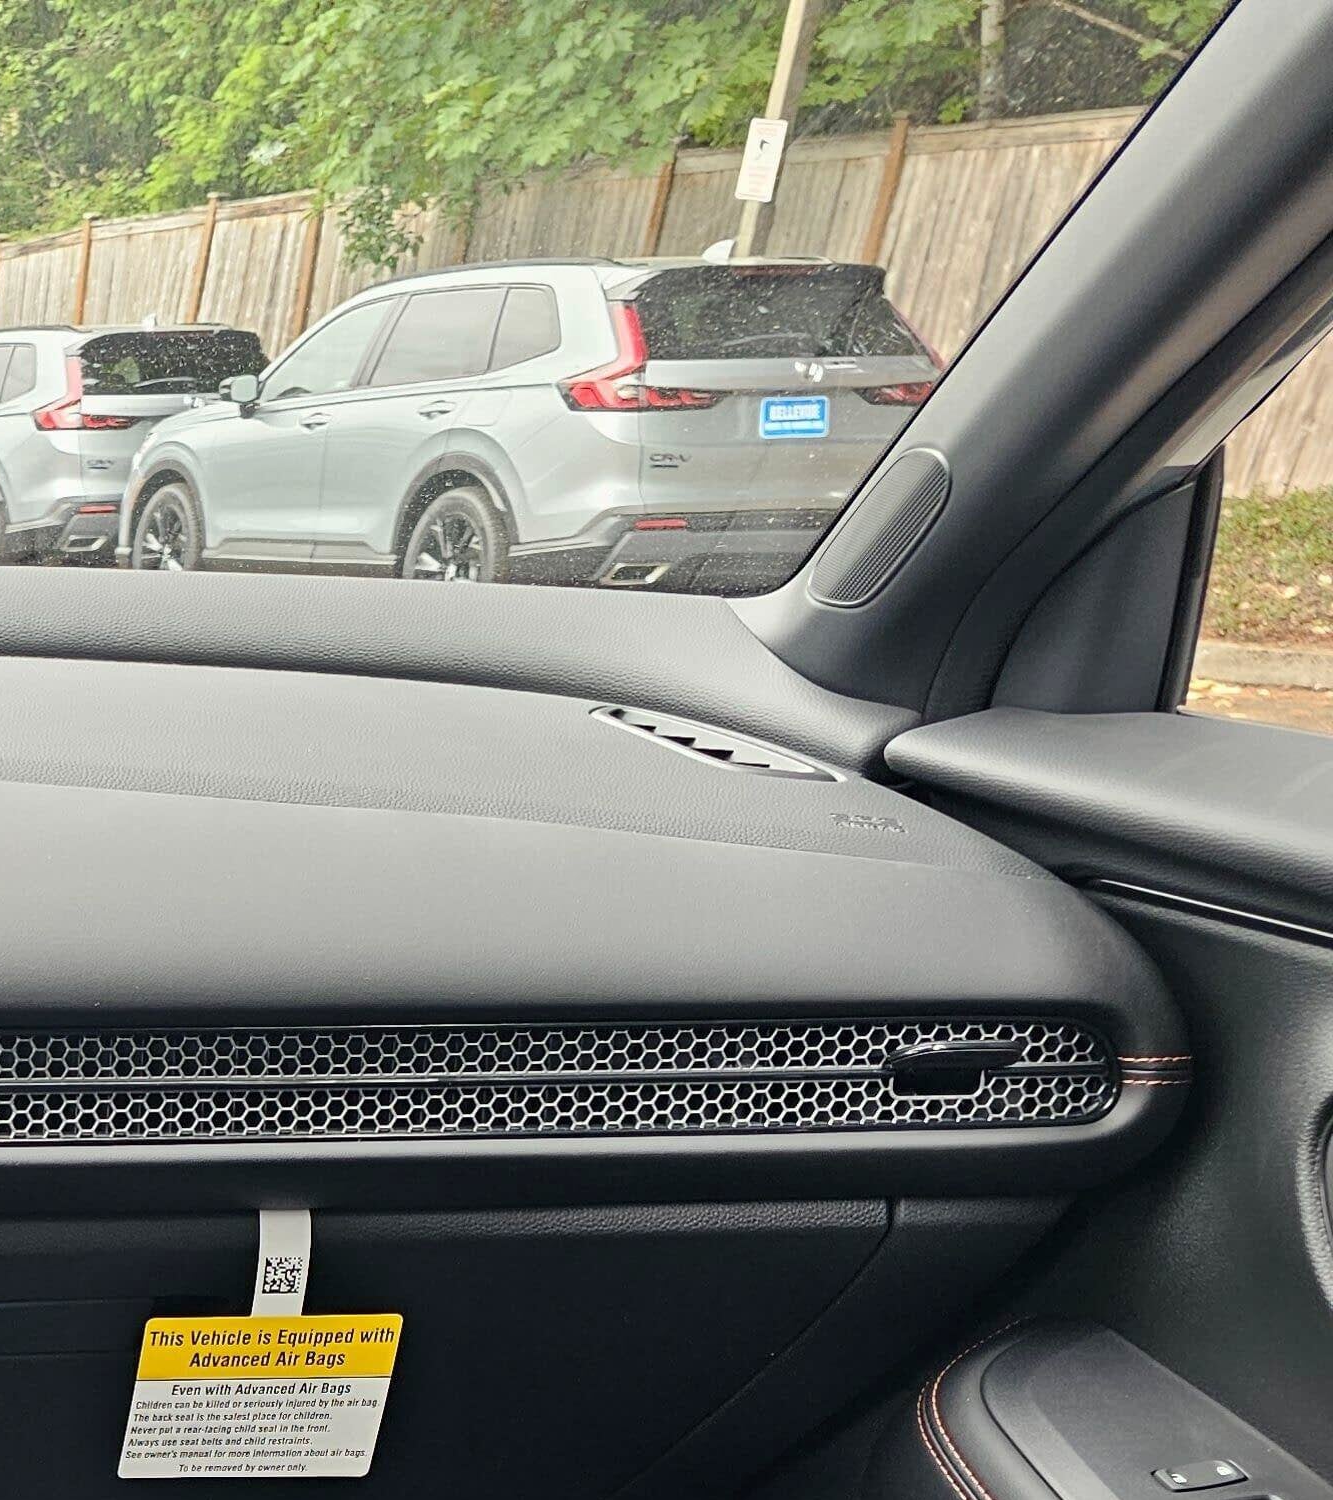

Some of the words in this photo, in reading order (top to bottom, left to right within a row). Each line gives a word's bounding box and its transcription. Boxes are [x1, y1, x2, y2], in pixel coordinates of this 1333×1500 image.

[150, 1331, 184, 1347] This
[191, 1330, 252, 1346] Vehicle
[258, 1330, 272, 1345] is
[278, 1329, 355, 1347] Equipped
[360, 1328, 395, 1343] with
[189, 1352, 271, 1368] Advanced
[275, 1352, 300, 1367] Air
[305, 1351, 346, 1369] Bags
[171, 1384, 201, 1396] Even
[205, 1384, 232, 1395] with
[234, 1383, 296, 1395] Advanced
[299, 1383, 318, 1394] Air
[321, 1383, 352, 1396] Bags
[136, 1401, 172, 1410] Children
[193, 1401, 204, 1409] be
[205, 1400, 230, 1408] killed
[243, 1399, 283, 1409] seriously
[285, 1399, 317, 1409] injured
[318, 1399, 329, 1409] by
[330, 1399, 345, 1407] the
[346, 1399, 360, 1407] air
[361, 1399, 381, 1408] bag.
[134, 1413, 150, 1422] The
[152, 1413, 172, 1421] back
[175, 1413, 194, 1421] seat
[196, 1413, 205, 1421] is
[207, 1413, 222, 1421] the
[223, 1412, 250, 1421] safest
[251, 1412, 277, 1422] place
[279, 1412, 292, 1420] for
[293, 1412, 333, 1420] children.
[130, 1426, 157, 1434] Never
[159, 1426, 174, 1435] put
[183, 1425, 232, 1435] rear-facing
[234, 1425, 256, 1433] child
[258, 1425, 278, 1433] seat
[306, 1424, 331, 1433] front.
[128, 1438, 160, 1448] Always
[180, 1438, 199, 1446] seat
[201, 1438, 223, 1446] belts
[225, 1437, 242, 1446] and
[244, 1437, 266, 1445] child
[268, 1437, 313, 1445] restraints.
[125, 1450, 142, 1459] See
[144, 1450, 178, 1459] owner's
[179, 1450, 213, 1458] manual
[252, 1449, 302, 1458] information
[304, 1449, 328, 1457] about
[344, 1449, 368, 1458] bags.
[179, 1464, 189, 1472] To
[191, 1464, 202, 1472] be
[204, 1464, 243, 1472] removed
[245, 1464, 256, 1473] by
[287, 1463, 308, 1473] only.
